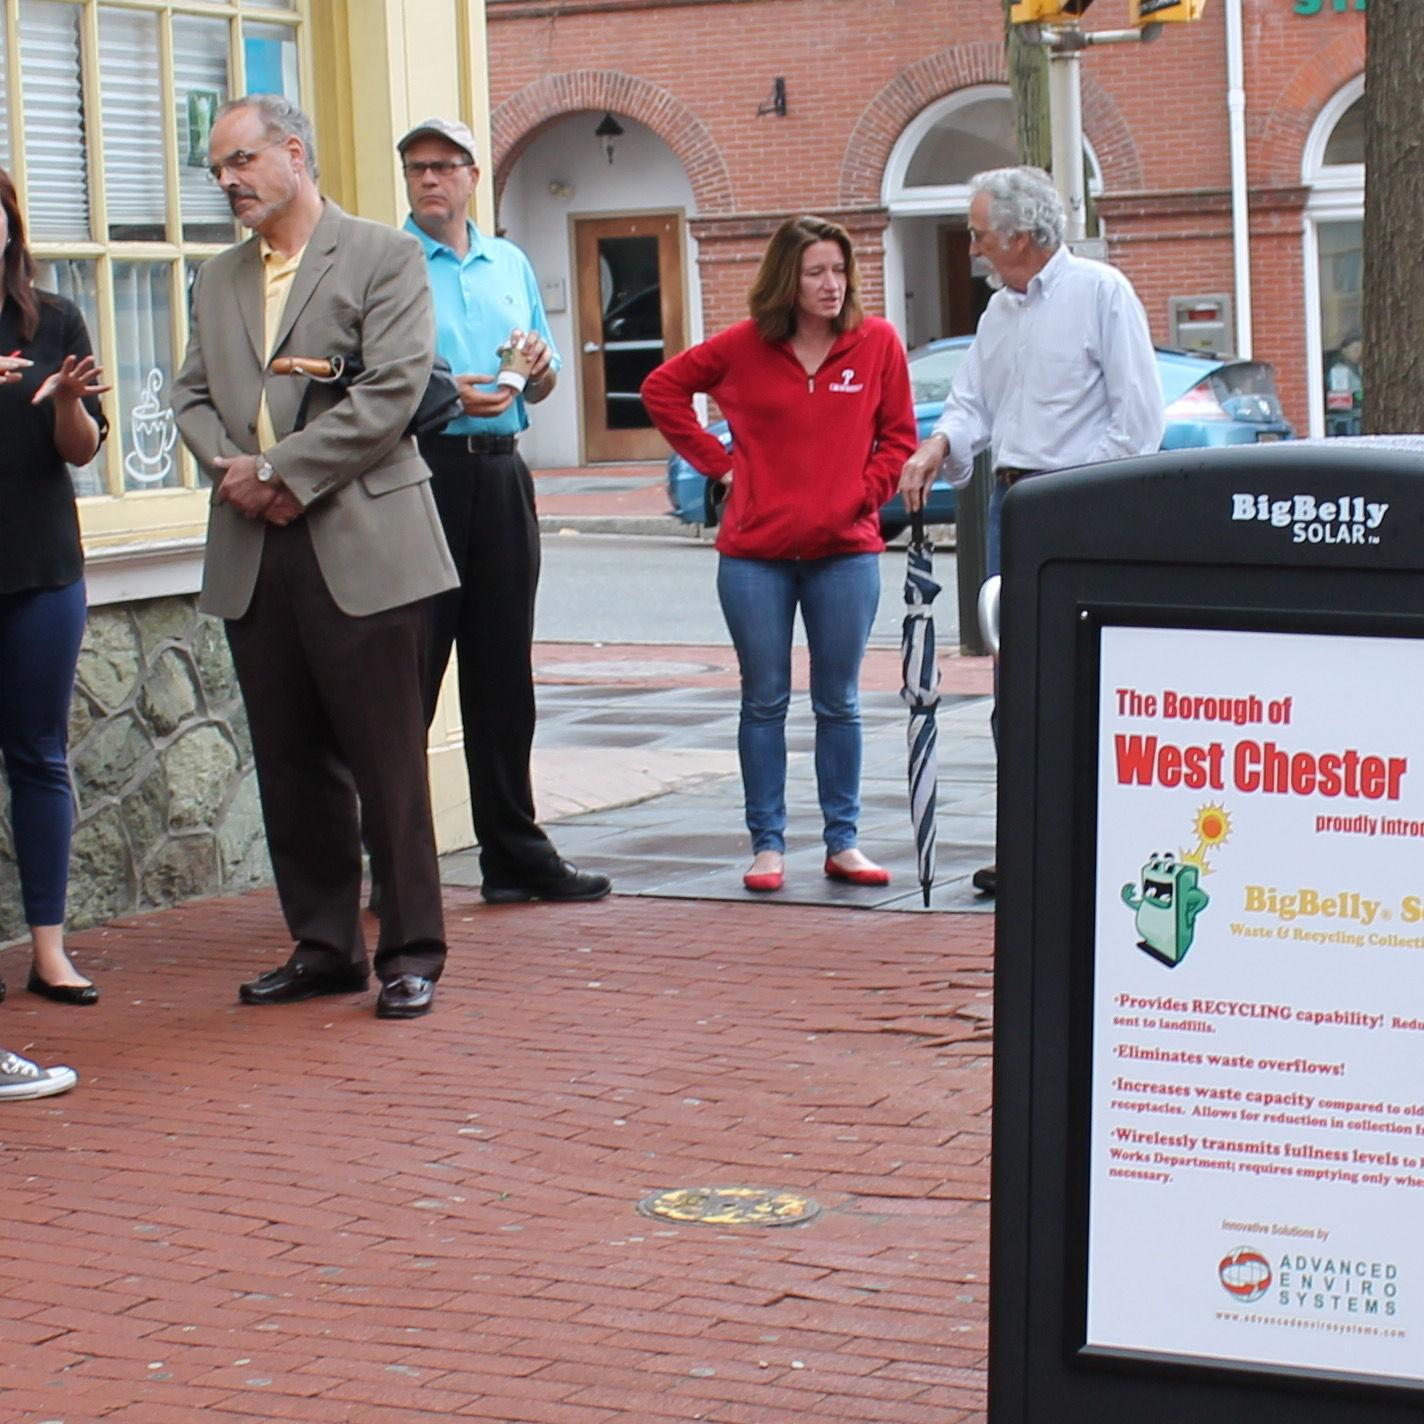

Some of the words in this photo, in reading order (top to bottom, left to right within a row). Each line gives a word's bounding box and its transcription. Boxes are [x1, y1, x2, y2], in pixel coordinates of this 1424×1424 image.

[1231, 492, 1389, 528] BigBelly
[1116, 688, 1158, 718] The
[1162, 691, 1263, 727] Borough
[1268, 695, 1293, 726] of
[1114, 733, 1225, 791] West
[1232, 739, 1408, 802] Chester
[1315, 814, 1378, 837] proudly
[1244, 885, 1381, 925] BigBelly
[1230, 922, 1273, 939] Waste
[1276, 927, 1289, 940] &
[1292, 928, 1365, 948] Recycling
[1112, 1015, 1139, 1028] sent
[1142, 1017, 1156, 1029] to
[1159, 1018, 1216, 1034] landfills.
[1119, 992, 1189, 1013] Provides
[1192, 999, 1292, 1020] RECYCLING
[1296, 1009, 1384, 1030] capability!
[1118, 1043, 1203, 1065] Eliminates
[1206, 1054, 1254, 1069] waste
[1258, 1058, 1346, 1077] overflows!
[1117, 1077, 1191, 1097] Increases
[1194, 1087, 1242, 1102] waste
[1245, 1090, 1315, 1110] capacity
[1318, 1098, 1383, 1115] compared
[1386, 1103, 1401, 1115] to
[1403, 1105, 1424, 1117] old
[1110, 1098, 1186, 1116] receptacles.
[1192, 1105, 1237, 1120] Allows
[1240, 1109, 1260, 1122] for
[1263, 1111, 1327, 1127] reduction
[1330, 1116, 1344, 1129] in
[1347, 1119, 1413, 1135] collection
[1116, 1126, 1198, 1151] Wirelessly
[1201, 1136, 1281, 1156] transmits
[1283, 1143, 1348, 1162] fullness
[1352, 1149, 1399, 1167] levels
[1402, 1156, 1417, 1169] to
[1109, 1147, 1150, 1163] Works
[1153, 1151, 1236, 1173] Department;
[1238, 1161, 1293, 1178] requires
[1295, 1166, 1359, 1185] emptying
[1361, 1173, 1391, 1187] only
[1109, 1166, 1174, 1185] necessary.
[1221, 1219, 1270, 1235] Innovative
[1270, 1223, 1316, 1239] Solutions
[1316, 1229, 1330, 1243] by
[1279, 1254, 1398, 1280] ADVANCED
[1279, 1272, 1397, 1298] ENVIRO
[1278, 1290, 1397, 1316] SYSTEMS
